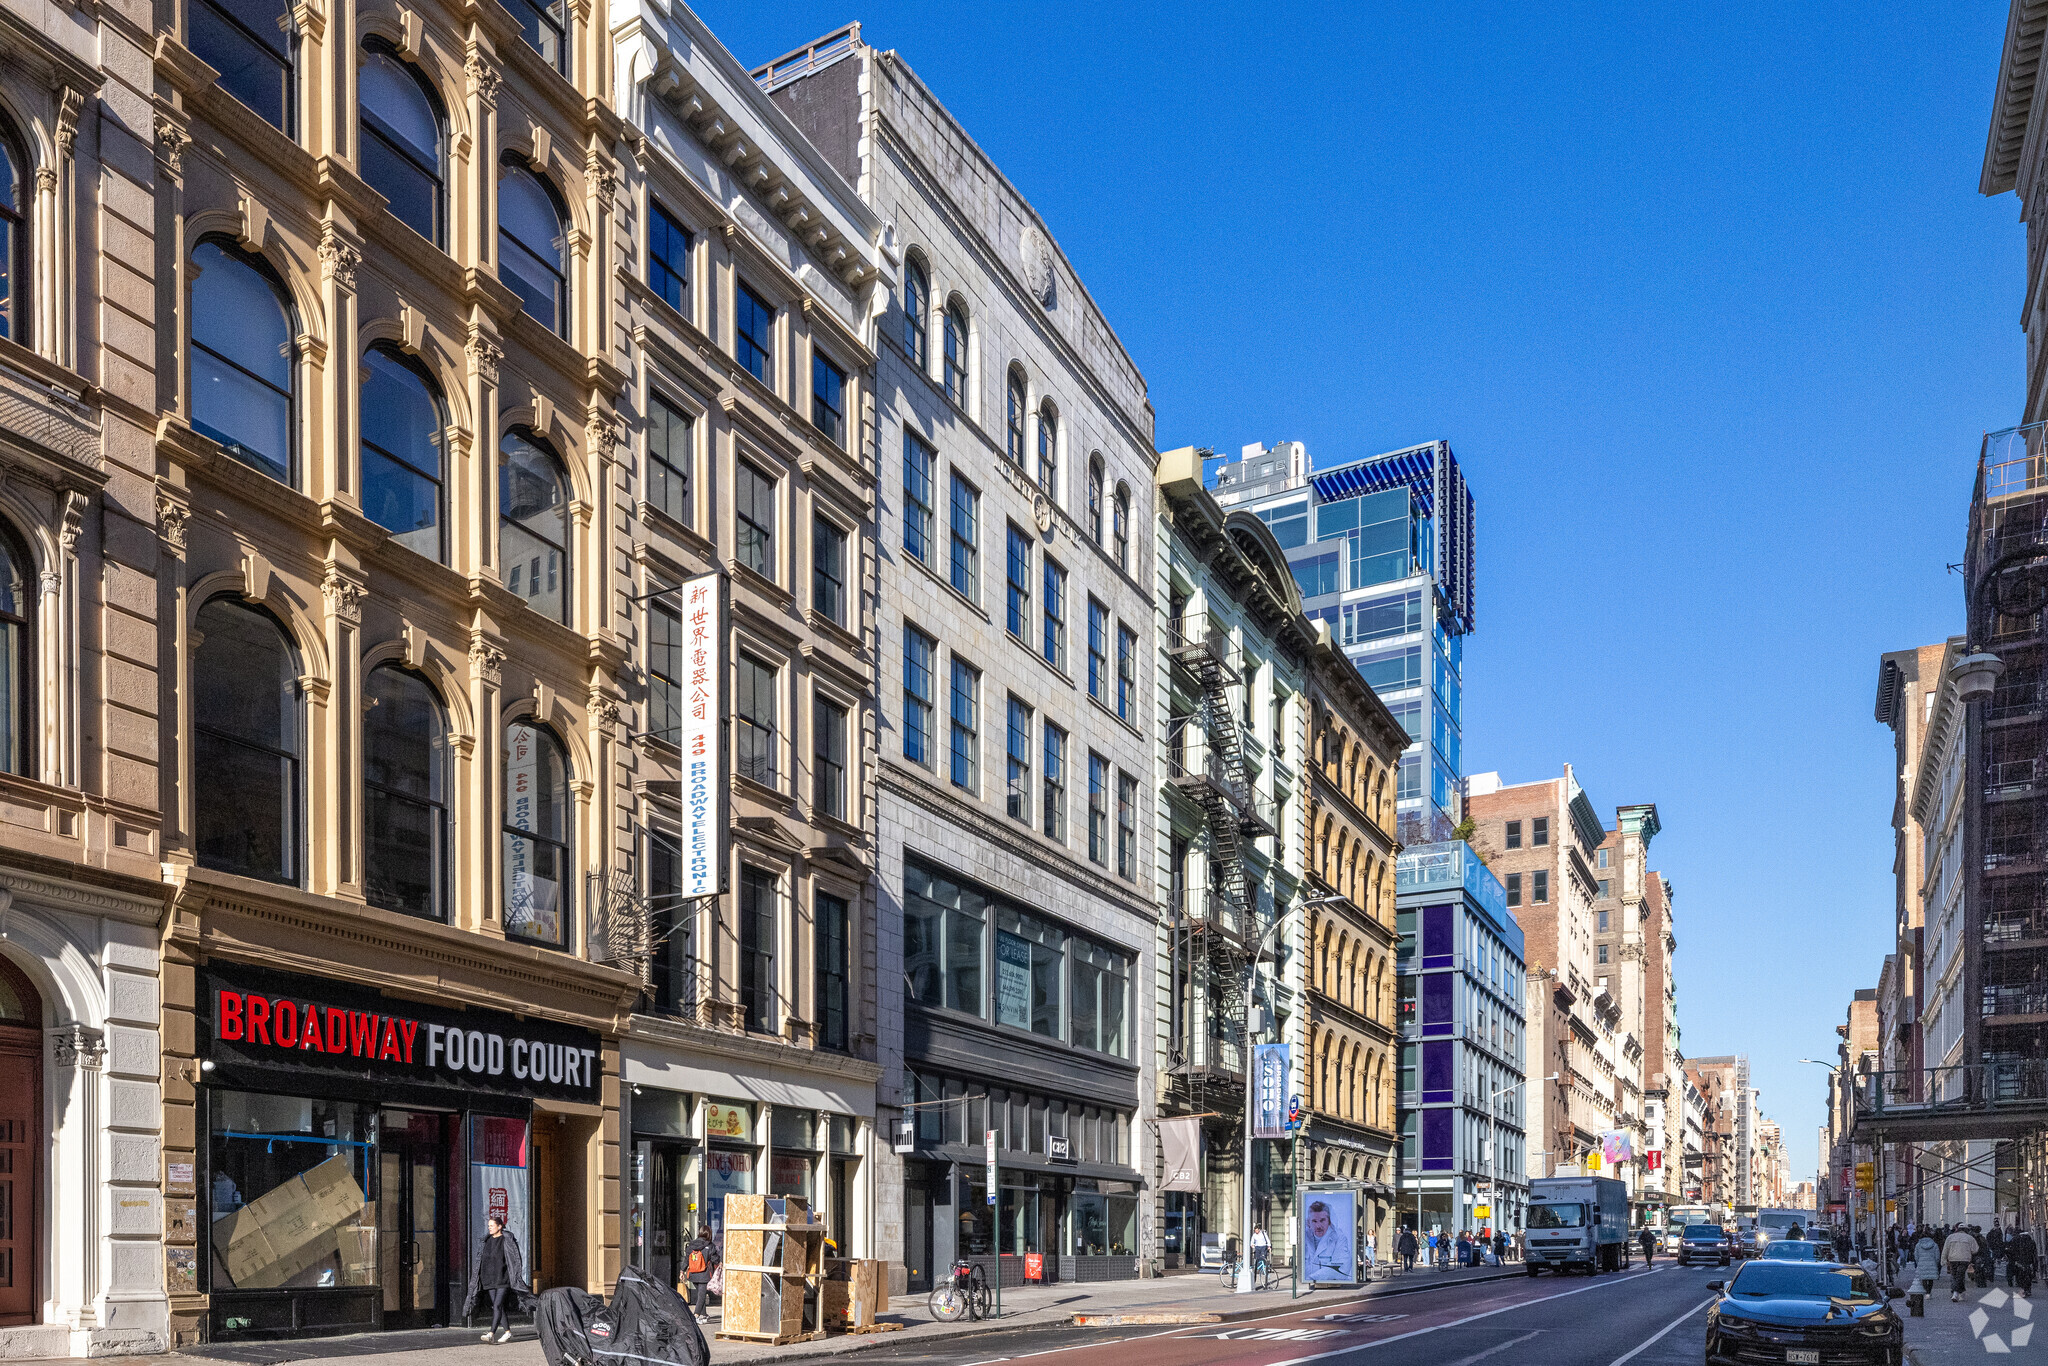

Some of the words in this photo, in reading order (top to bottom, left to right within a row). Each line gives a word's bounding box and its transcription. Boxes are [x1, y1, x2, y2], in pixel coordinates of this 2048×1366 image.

[690, 585, 710, 721] 新世界電器公司
[691, 733, 706, 757] 449
[1011, 948, 1028, 964] LEASE
[219, 990, 419, 1064] BROADWAY
[426, 1022, 504, 1076] FOOD
[511, 1037, 596, 1088] COURT
[1173, 1172, 1191, 1180] CB2
